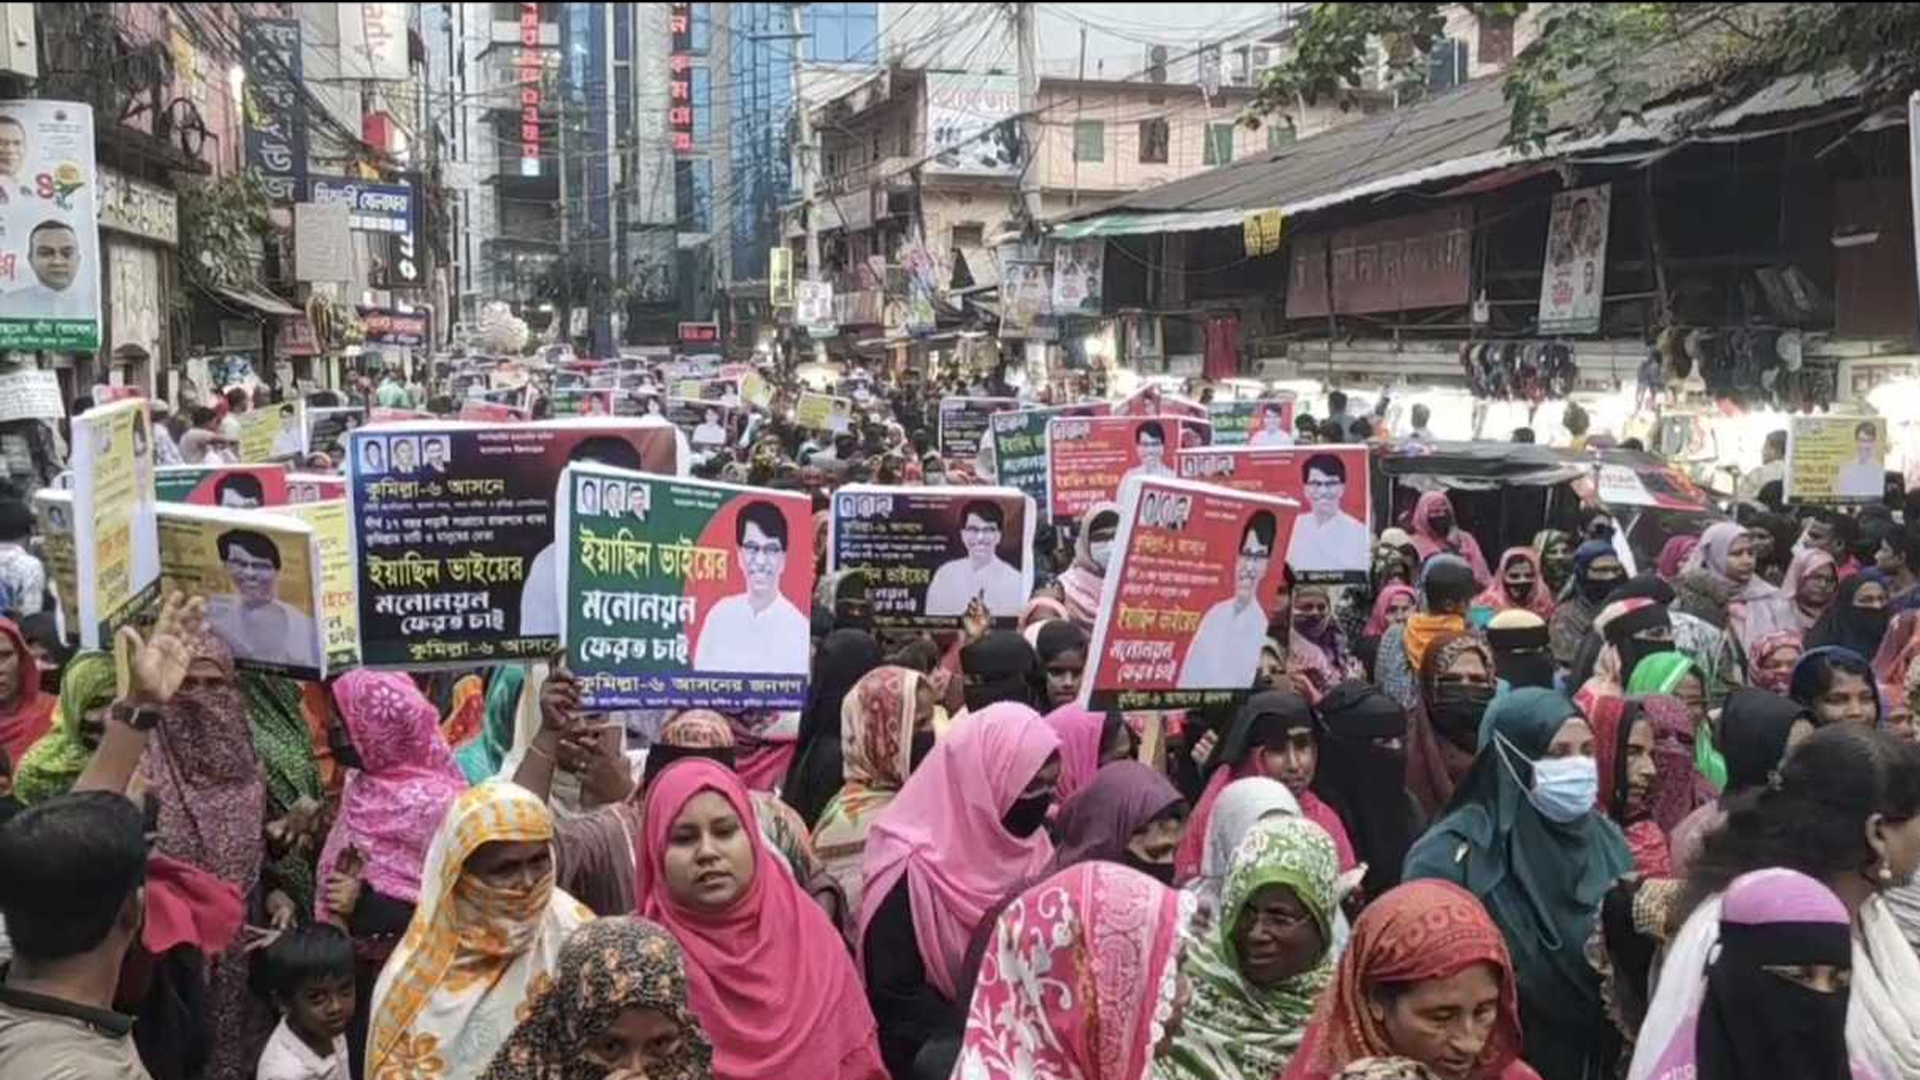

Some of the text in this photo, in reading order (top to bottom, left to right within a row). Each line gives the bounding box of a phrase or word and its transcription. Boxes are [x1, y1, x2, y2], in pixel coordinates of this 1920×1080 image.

[448, 479, 504, 496] আসনে
[579, 523, 728, 583] ইয়াছিন ভাইয়ের
[366, 551, 523, 589] ইয়াছিন ভাইয়ের
[375, 591, 489, 615] মনোনয়ন
[581, 589, 696, 628] মনোনয়ন
[401, 608, 505, 635] ফেরত চাই
[580, 634, 688, 664] ফেরত চাই
[1110, 640, 1175, 663] মনোনয়ন
[672, 677, 742, 693] আসনের
[749, 679, 801, 693] জনগণ
